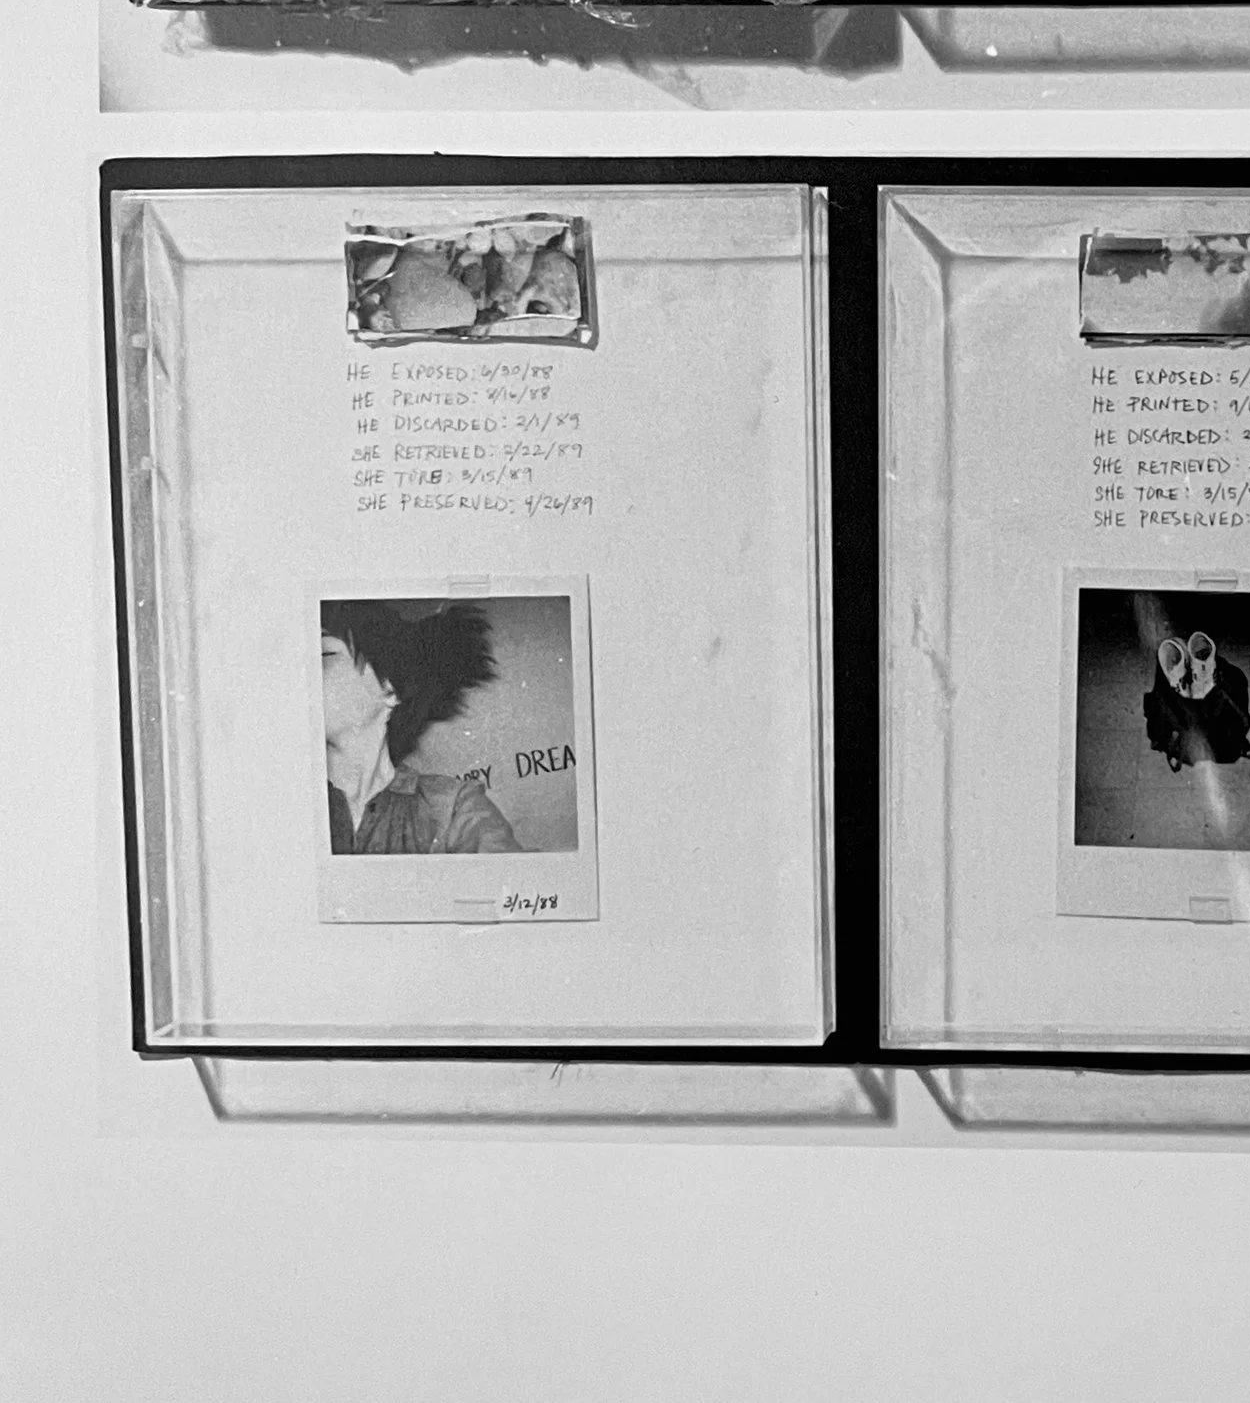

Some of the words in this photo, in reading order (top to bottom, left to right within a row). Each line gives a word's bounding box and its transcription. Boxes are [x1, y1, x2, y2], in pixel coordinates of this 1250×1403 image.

[347, 363, 370, 382] HE
[1091, 366, 1118, 386] HE
[1135, 368, 1221, 386] EXPOSED:
[352, 391, 374, 410] HE
[392, 390, 478, 407] PRINTED:
[1093, 395, 1115, 414] HE
[1127, 396, 1218, 413] PRINTED:
[357, 418, 379, 432] HE
[394, 416, 507, 432] DISCARDED:
[516, 412, 580, 432] 2/1/89
[1094, 427, 1117, 447] HE
[1128, 428, 1232, 446] DISCARDED:
[352, 447, 381, 462] SHE
[503, 441, 583, 461] 2/22/89
[1093, 455, 1123, 475] SHE
[1138, 457, 1240, 475] RETRIEVED:
[353, 470, 386, 487] SHE
[461, 464, 533, 485] 3/15/89
[1095, 484, 1125, 502] SHE
[1134, 486, 1190, 502] TORE:
[357, 497, 387, 512] SHE
[400, 496, 515, 514] PRESERVED:
[525, 494, 593, 517] 4/26/89
[1094, 508, 1126, 528] SHE
[1140, 509, 1250, 528] PRESERVED:
[503, 892, 558, 915] 3/12/88
